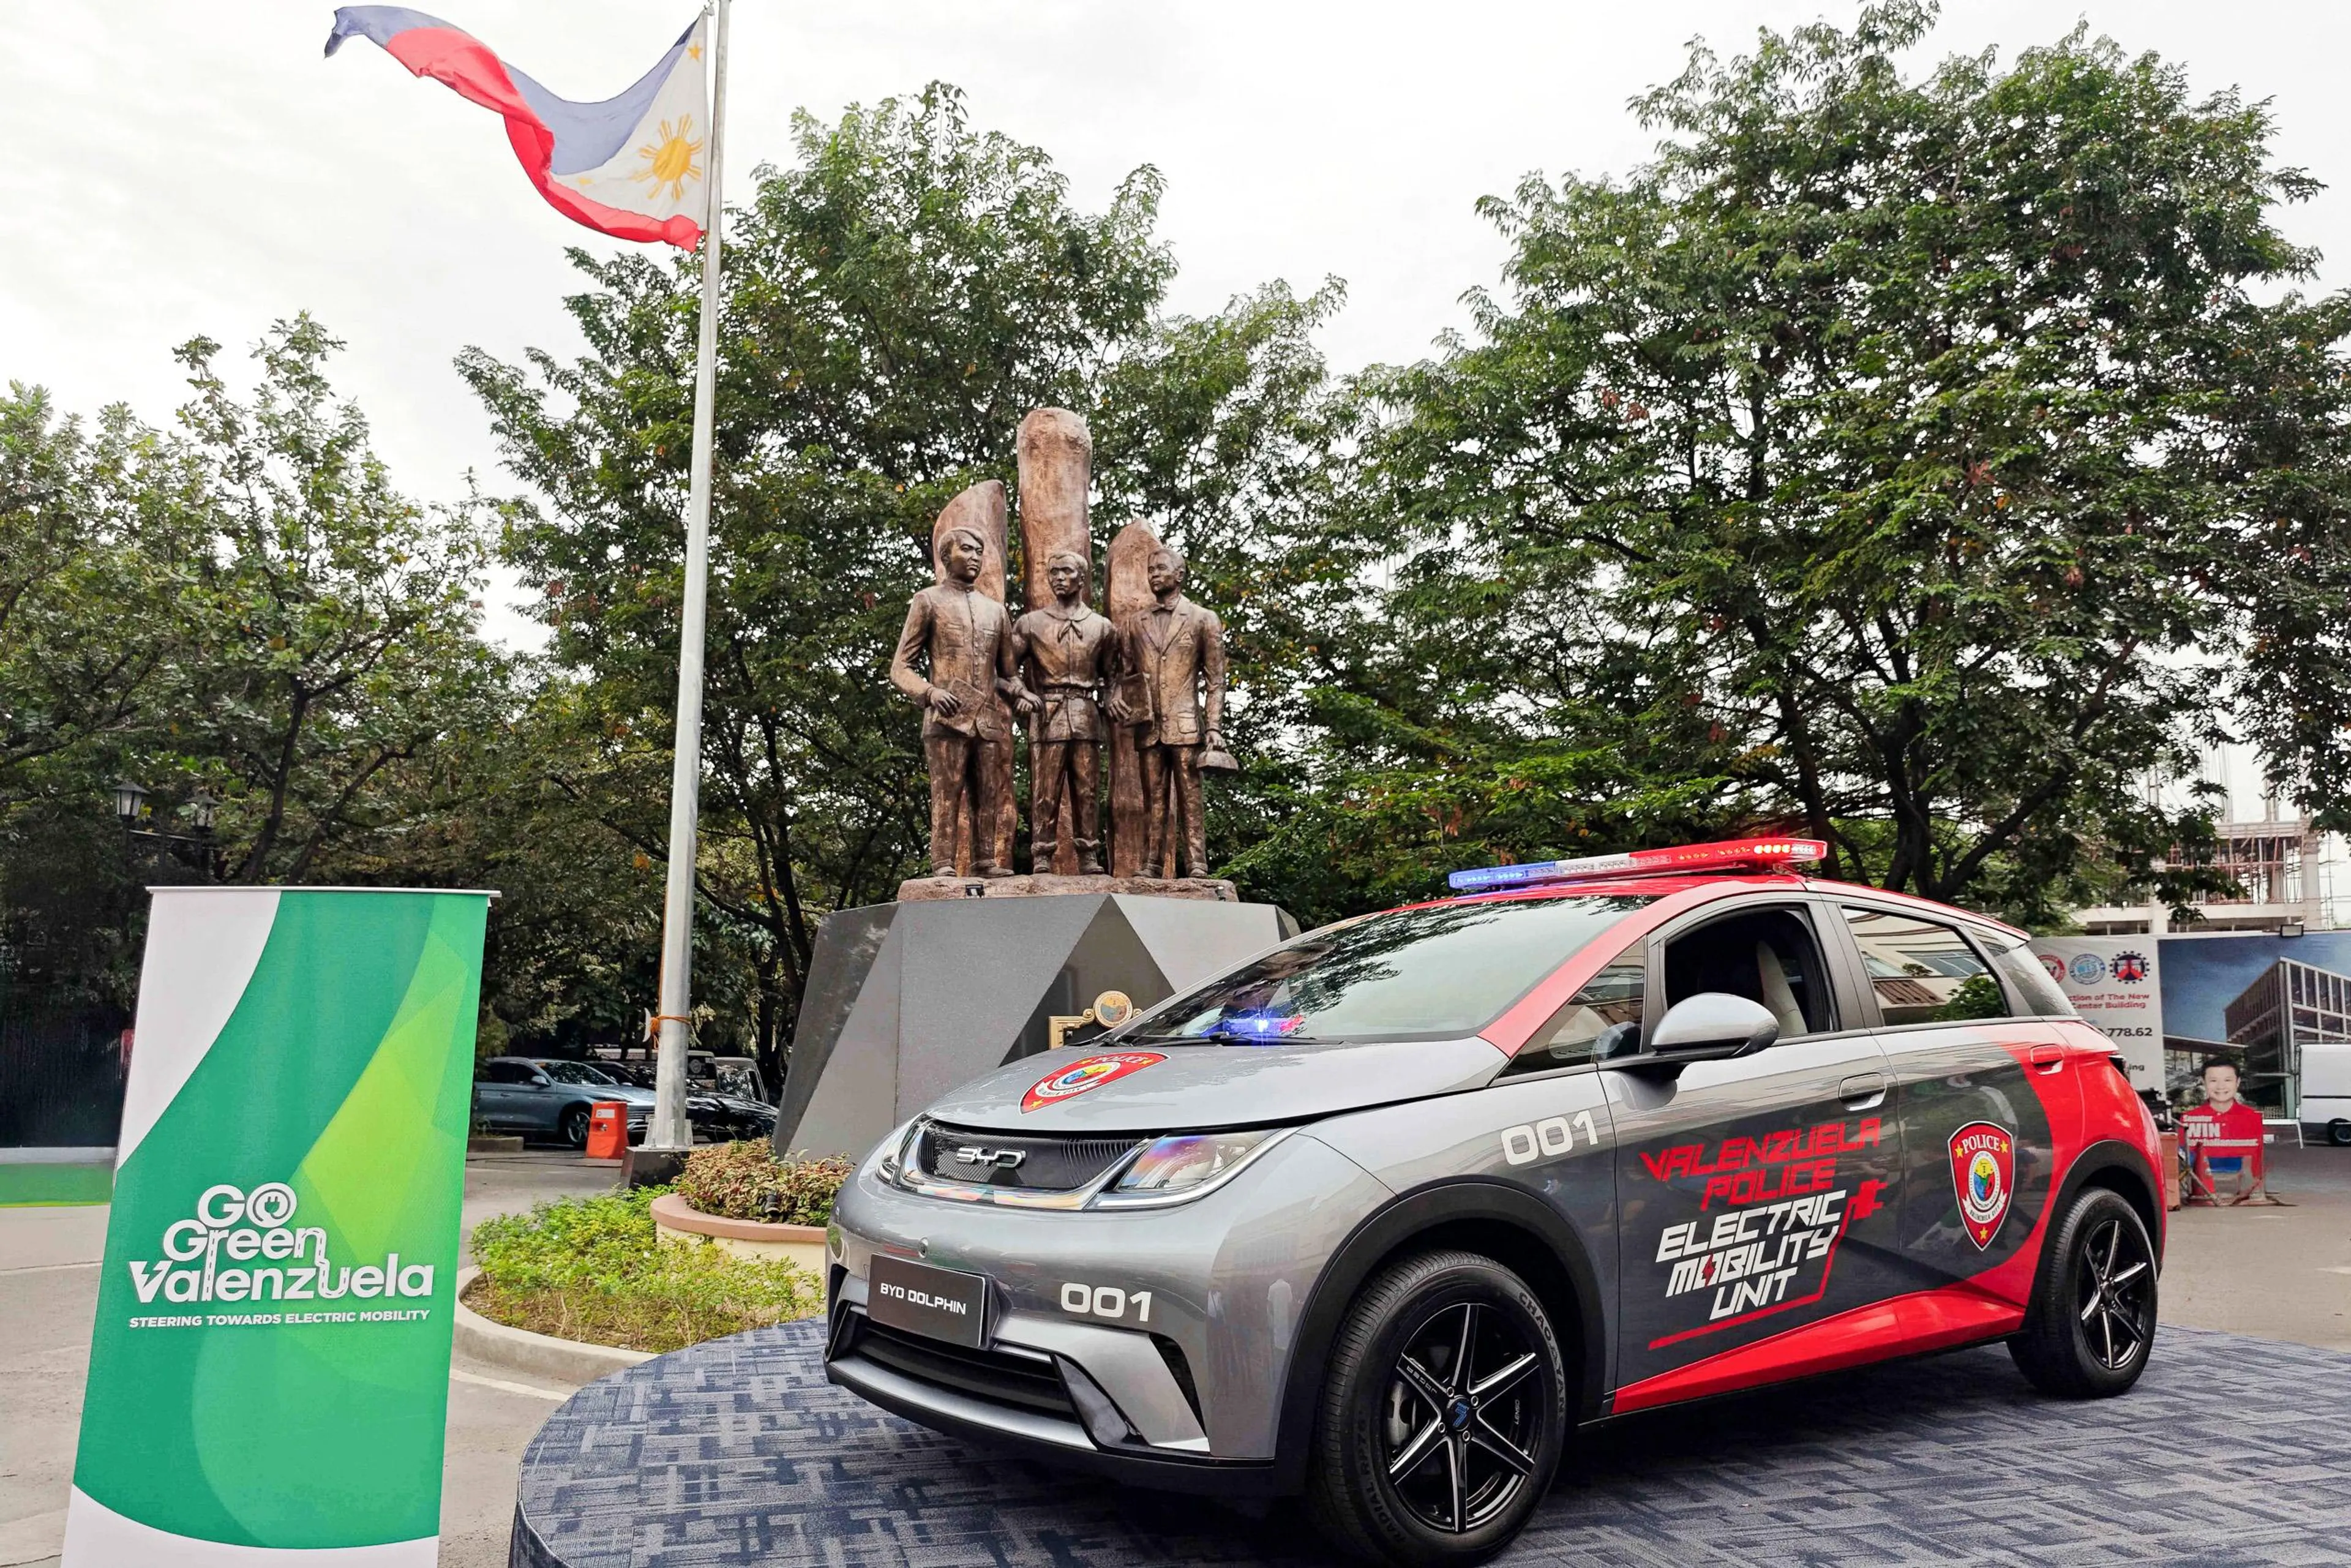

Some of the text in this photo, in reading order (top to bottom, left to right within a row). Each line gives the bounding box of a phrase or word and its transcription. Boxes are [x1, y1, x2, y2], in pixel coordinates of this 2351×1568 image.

[1091, 1054, 1149, 1065] POLICE
[1501, 1110, 1599, 1165] 001
[1638, 1117, 1882, 1181] VALENZUELA
[1962, 1134, 2001, 1155] POLICE
[2187, 1122, 2221, 1138] WIN
[956, 1146, 1026, 1168] BYD
[197, 1182, 298, 1228] GO
[1700, 1158, 1836, 1212] POLICE
[163, 1219, 327, 1262] Green
[1655, 1190, 1847, 1262] ELECTRIC
[127, 1253, 434, 1303] Valenzuela
[1665, 1225, 1840, 1298] MOBILITY
[880, 1283, 967, 1315] BYD DOLPHIN
[1060, 1282, 1152, 1322] 001
[1709, 1267, 1798, 1321] UNIT
[129, 1310, 430, 1328] STEERING TOWARDS ELECTRIC MOBILITY
